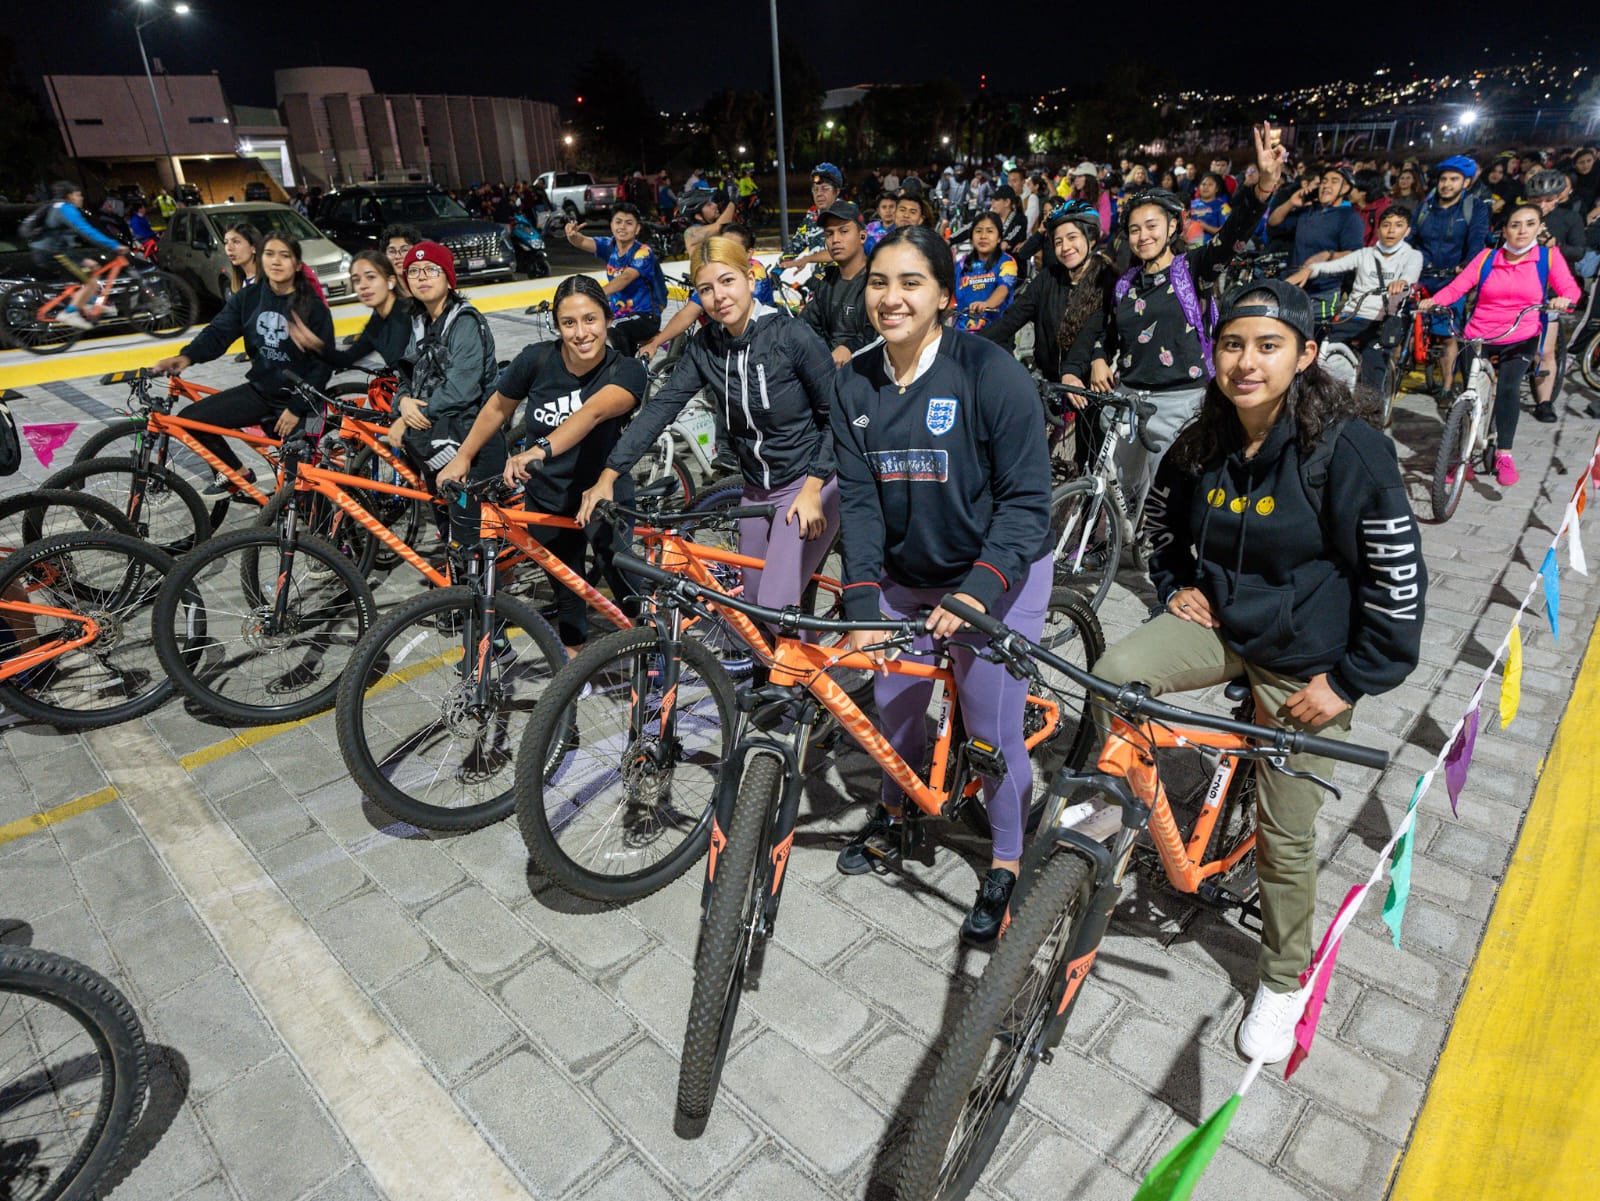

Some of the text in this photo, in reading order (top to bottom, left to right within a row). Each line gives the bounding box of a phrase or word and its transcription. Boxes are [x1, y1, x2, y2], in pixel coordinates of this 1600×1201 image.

[1361, 515, 1418, 620] HAPPY
[617, 641, 657, 656] FAST TRAK
